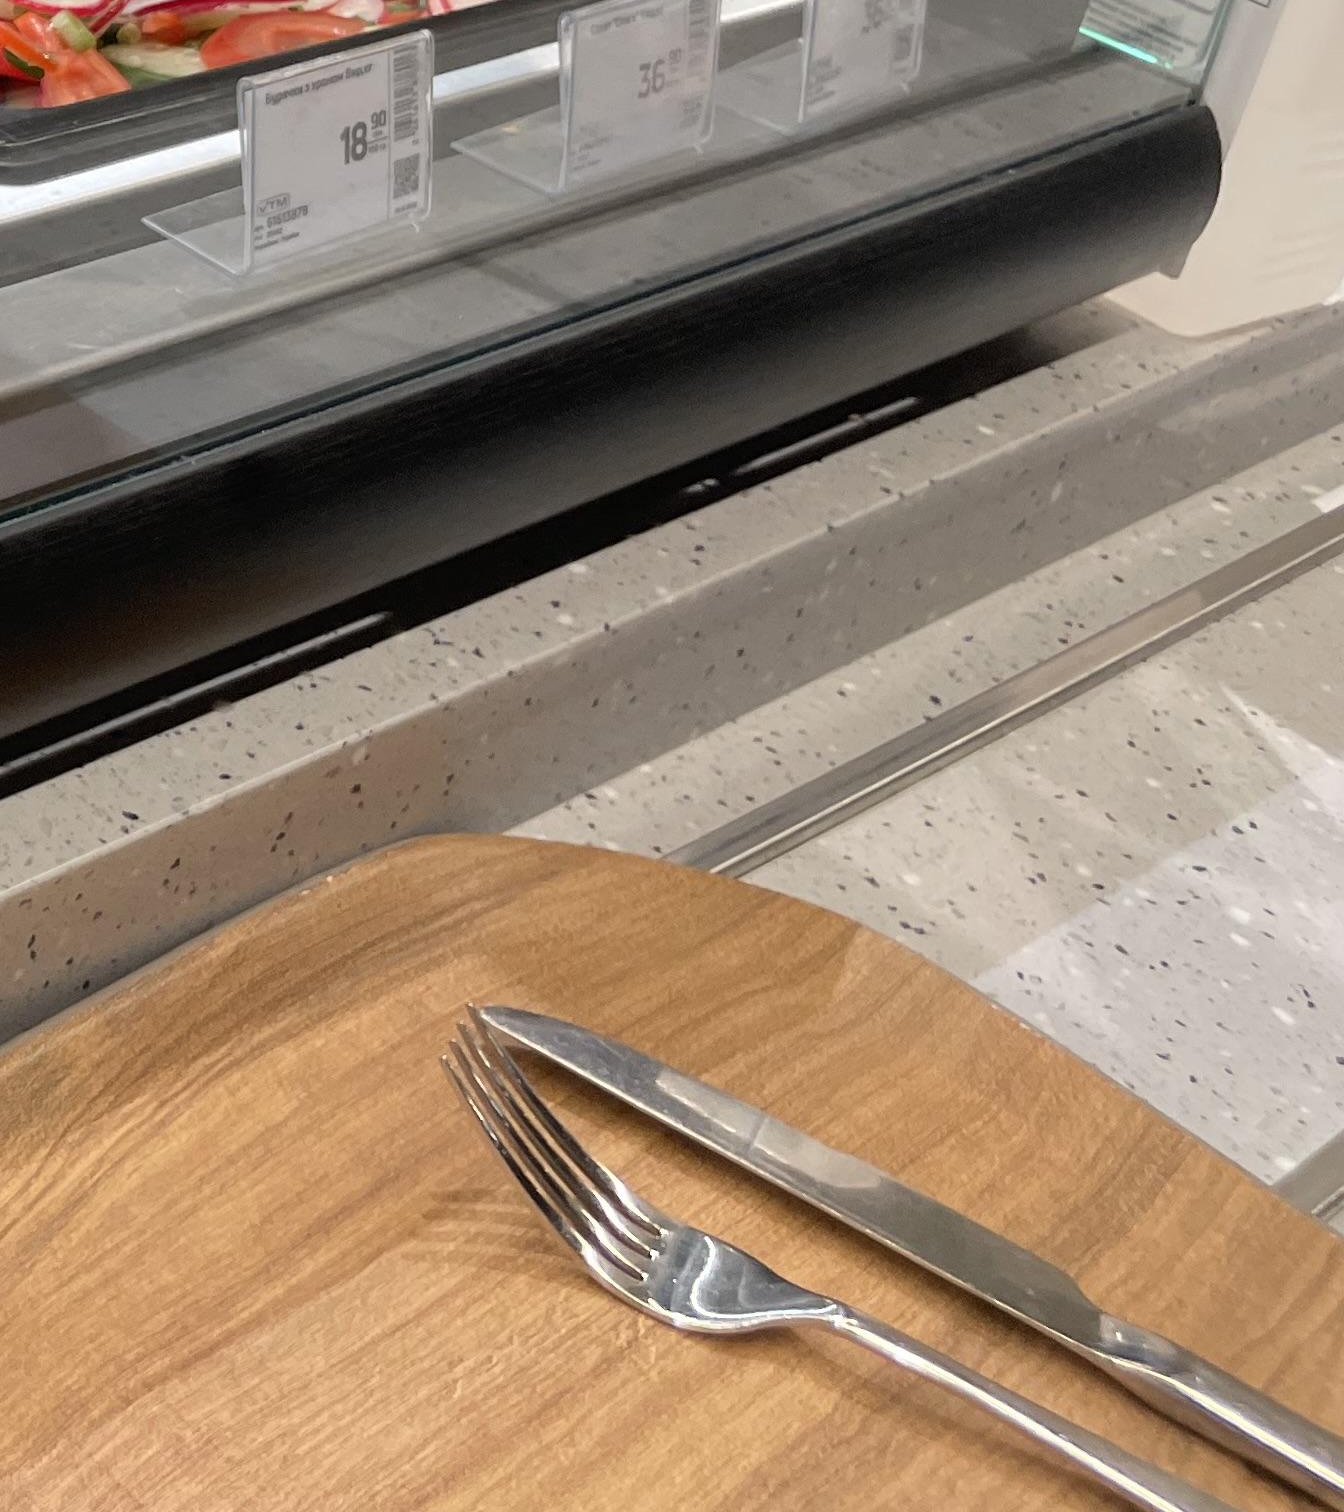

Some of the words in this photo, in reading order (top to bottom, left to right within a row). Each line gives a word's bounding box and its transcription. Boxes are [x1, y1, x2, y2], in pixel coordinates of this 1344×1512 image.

[637, 58, 666, 99] 36
[371, 109, 387, 130] 90
[339, 121, 368, 165] 18
